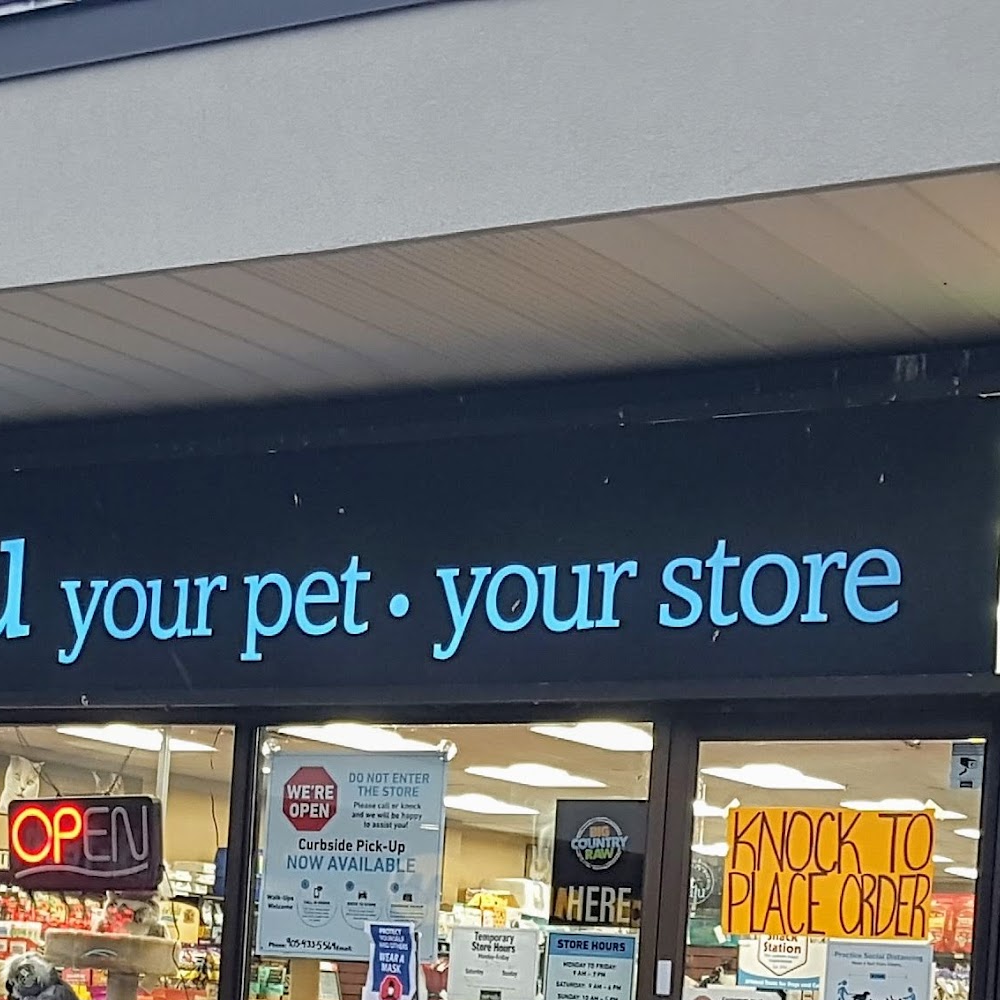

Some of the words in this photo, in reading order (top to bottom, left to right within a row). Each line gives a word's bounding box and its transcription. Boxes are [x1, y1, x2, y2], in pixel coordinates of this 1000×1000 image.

[57, 574, 227, 664] your
[239, 555, 372, 662] pet
[432, 560, 638, 661] your
[658, 539, 902, 628] store
[348, 773, 364, 784] DO
[366, 773, 390, 784] NOT
[392, 773, 430, 784] ENTER
[286, 785, 334, 800] WE'RE
[358, 786, 379, 796] THE
[382, 786, 419, 797] STORE
[289, 802, 330, 818] OPEN
[351, 811, 364, 819] and
[11, 805, 148, 864] OPEN
[298, 838, 353, 852] Curbside
[356, 840, 406, 855] Pick-Up
[571, 836, 629, 850] COUNTRY
[732, 810, 862, 874] KNOCK
[878, 813, 934, 873] TO
[585, 847, 615, 860] RAW
[286, 855, 324, 870] NOW
[327, 856, 416, 873] AVAILABLE
[566, 886, 632, 924] HERE
[728, 871, 828, 935] PLACE
[839, 873, 931, 938] ORDER
[474, 931, 514, 944] Temporary
[472, 942, 492, 952] Store
[493, 942, 516, 953] Hours
[557, 939, 589, 950] STORE
[591, 941, 626, 952] HOURS
[764, 942, 802, 954] Station
[379, 952, 399, 962] WEAR
[399, 954, 405, 964] A
[834, 951, 862, 959] Practice
[864, 952, 884, 960] Social
[886, 953, 923, 962] Distancing
[381, 962, 402, 974] MASK
